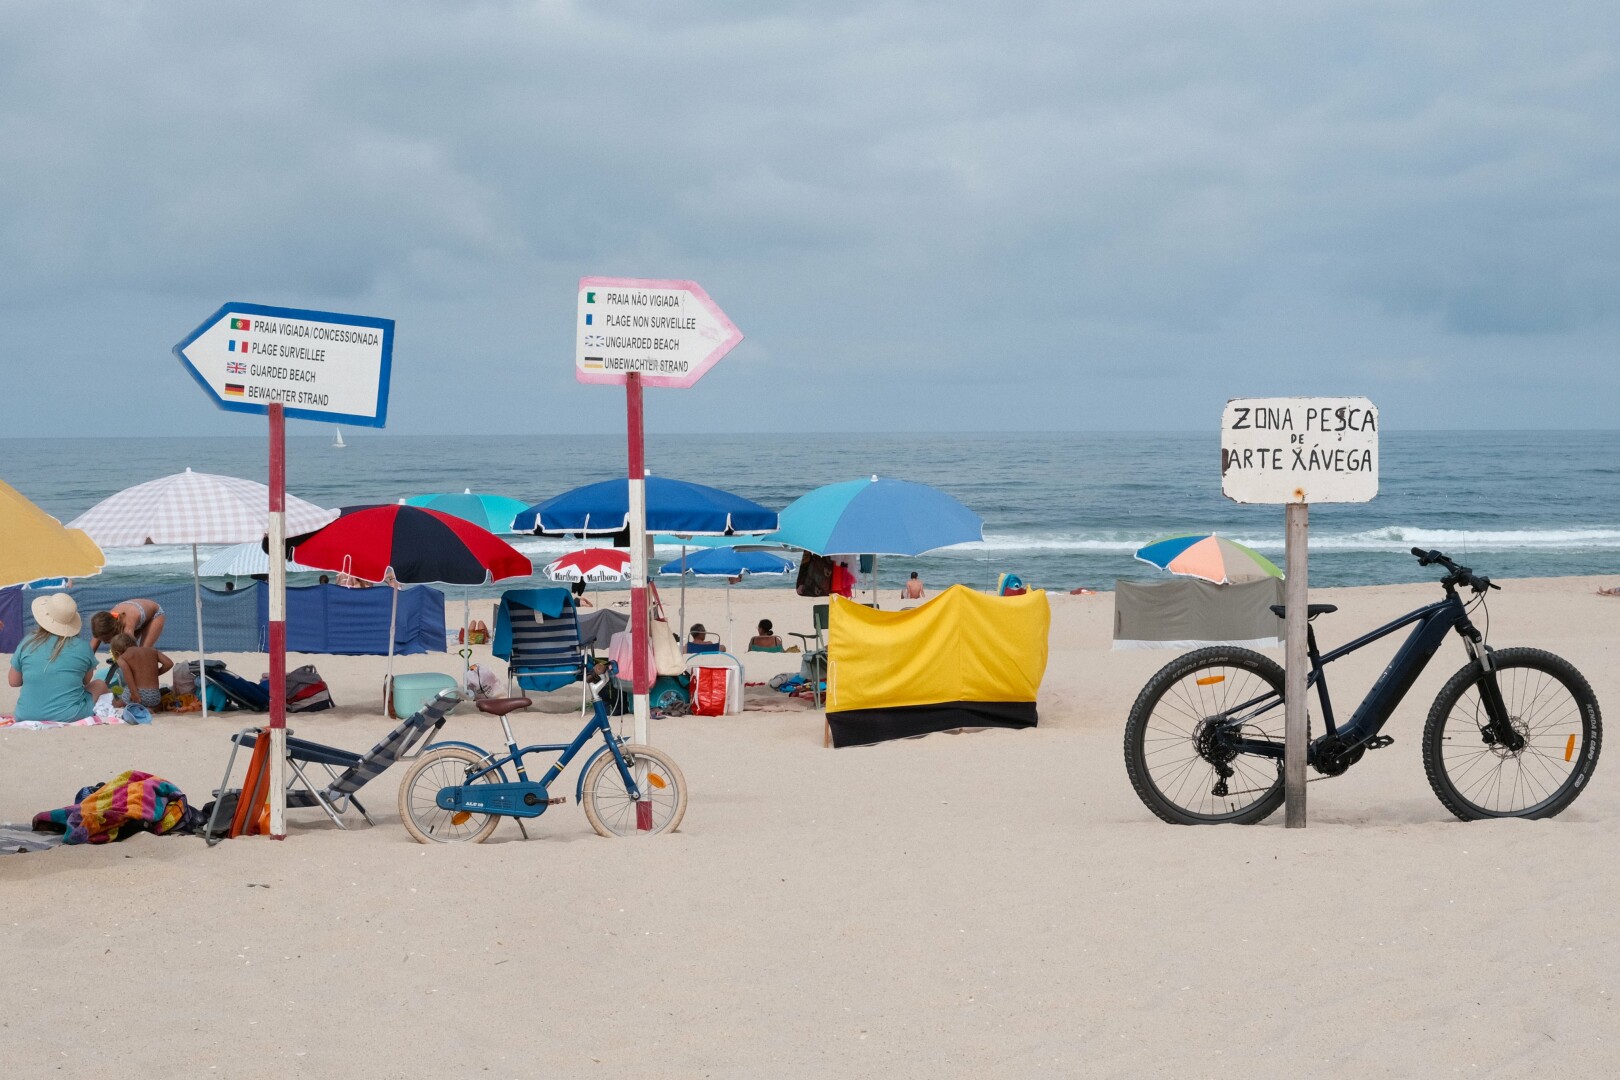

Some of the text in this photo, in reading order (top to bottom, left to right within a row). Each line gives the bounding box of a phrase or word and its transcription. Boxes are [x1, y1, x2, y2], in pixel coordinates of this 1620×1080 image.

[607, 292, 680, 307] PRAIA NÃO VIGIADA
[606, 314, 696, 330] PLAGE NON SURVEILLEE
[254, 320, 379, 346] PRAIA VIGIADA/CONCESSIONADA
[606, 336, 680, 350] UNGUARDED BEACH
[252, 342, 326, 362] PLAGE SURVEILLEE
[250, 364, 316, 382] GUARDED BEACH
[604, 358, 688, 372] UNBEWACHTER STRAND
[248, 386, 329, 406] BEWACHTER STRAND
[1232, 406, 1376, 432] ZONA PESCA
[1290, 434, 1304, 444] DE
[1228, 444, 1372, 472] ARTE XÁVEGA
[586, 570, 618, 582] Marlboro
[1172, 662, 1198, 679] KENDA
[1586, 703, 1597, 760] KENDA EL CAPO
